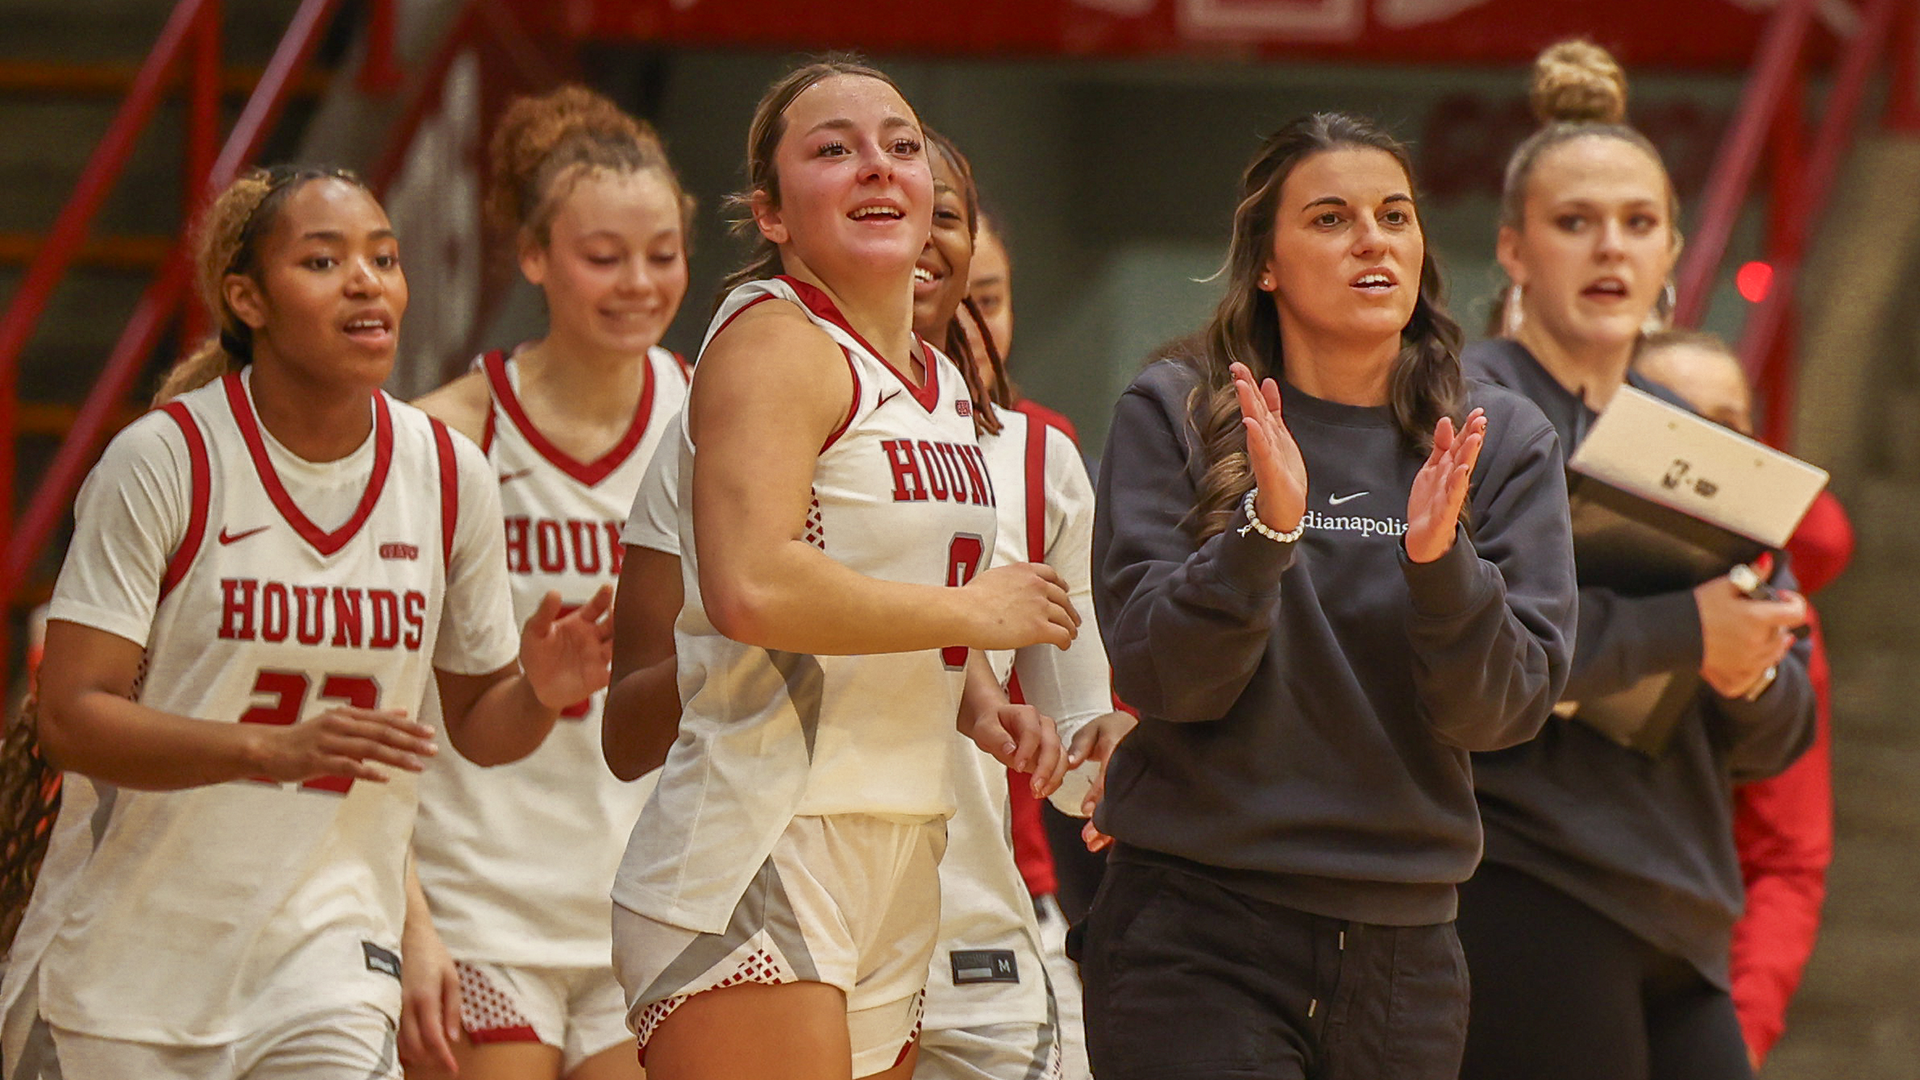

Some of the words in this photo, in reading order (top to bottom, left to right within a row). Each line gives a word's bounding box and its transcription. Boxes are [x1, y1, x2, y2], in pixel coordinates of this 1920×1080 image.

[880, 438, 997, 508] HOUN
[218, 578, 426, 651] HOUNDS
[997, 958, 1011, 973] M
